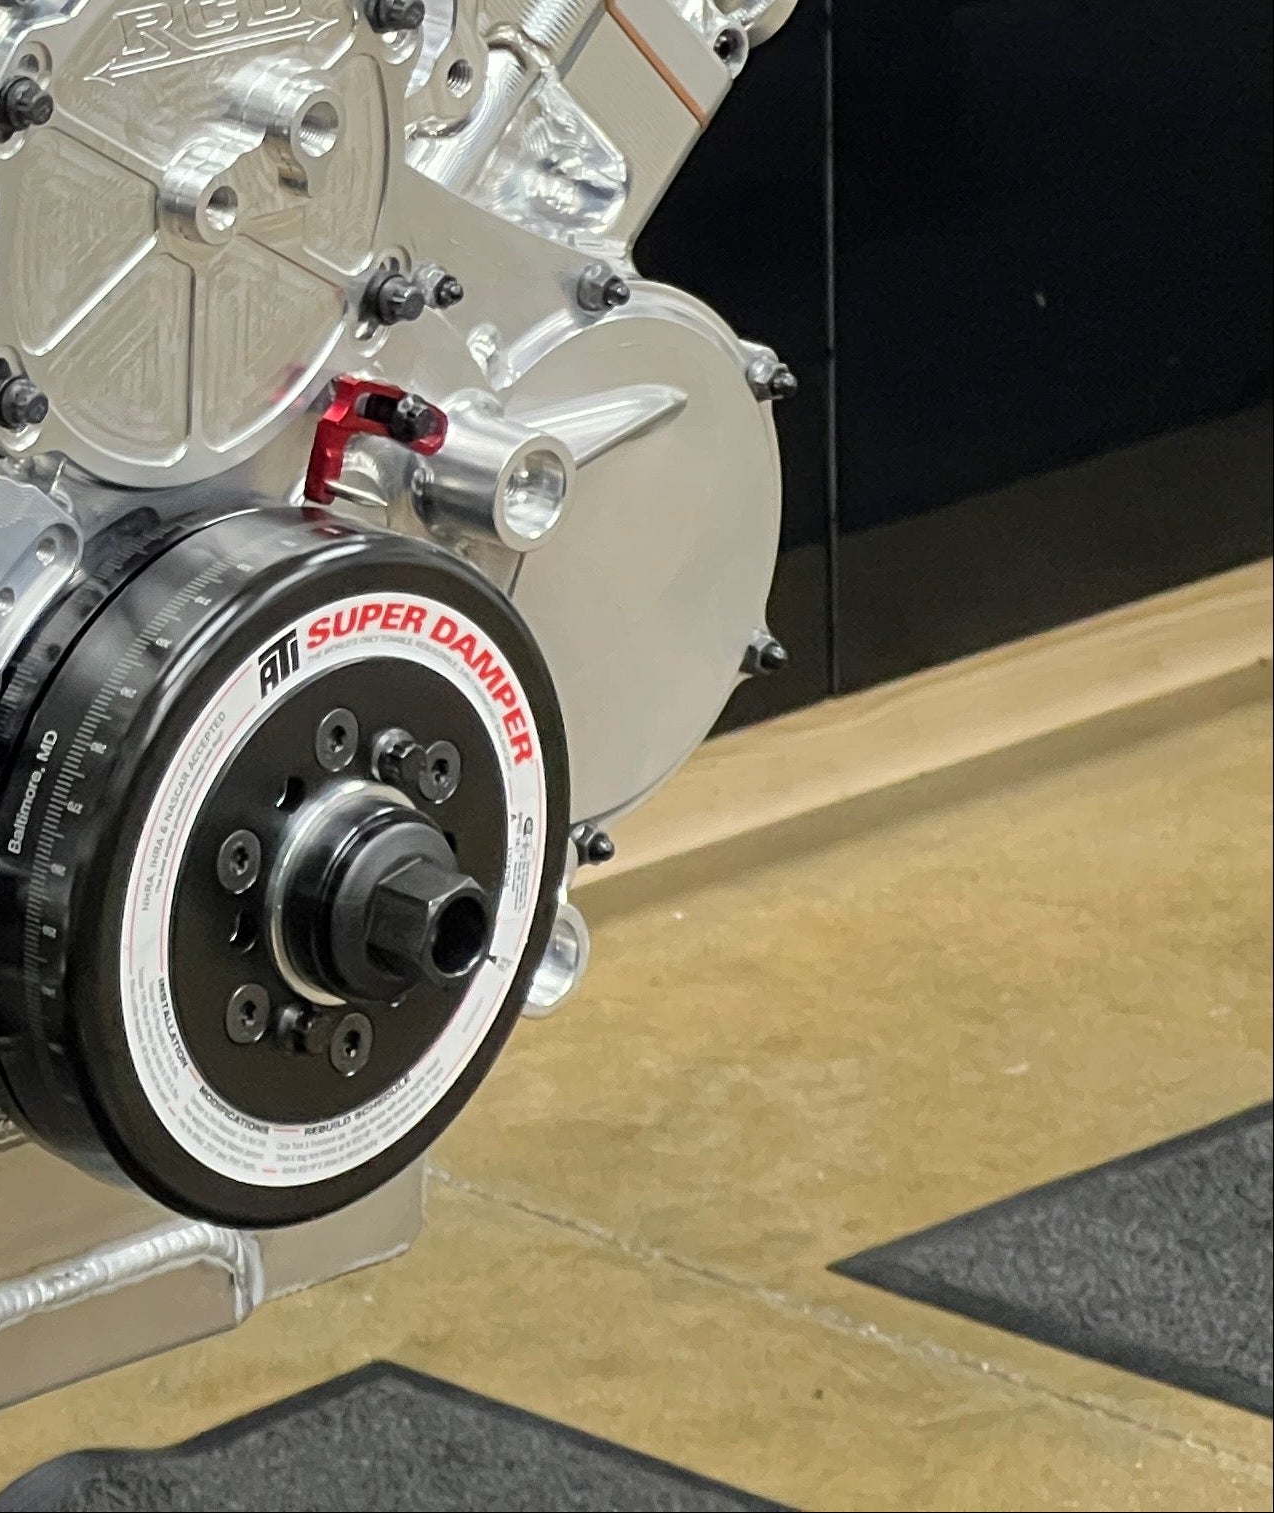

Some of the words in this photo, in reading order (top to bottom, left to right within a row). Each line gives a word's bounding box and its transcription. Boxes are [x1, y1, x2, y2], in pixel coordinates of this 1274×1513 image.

[257, 628, 301, 701] ATI
[306, 602, 429, 650] SUPER
[429, 614, 535, 766] DAMPER
[36, 730, 59, 763] MD
[187, 710, 227, 773] ACCEPTED
[163, 769, 191, 824] NASCAR
[150, 838, 165, 869] IHRA
[160, 824, 169, 835] &
[158, 976, 189, 1070] INSTALLATION
[199, 1084, 271, 1136] MODIFICATIONS
[304, 1115, 353, 1137] REBUILD
